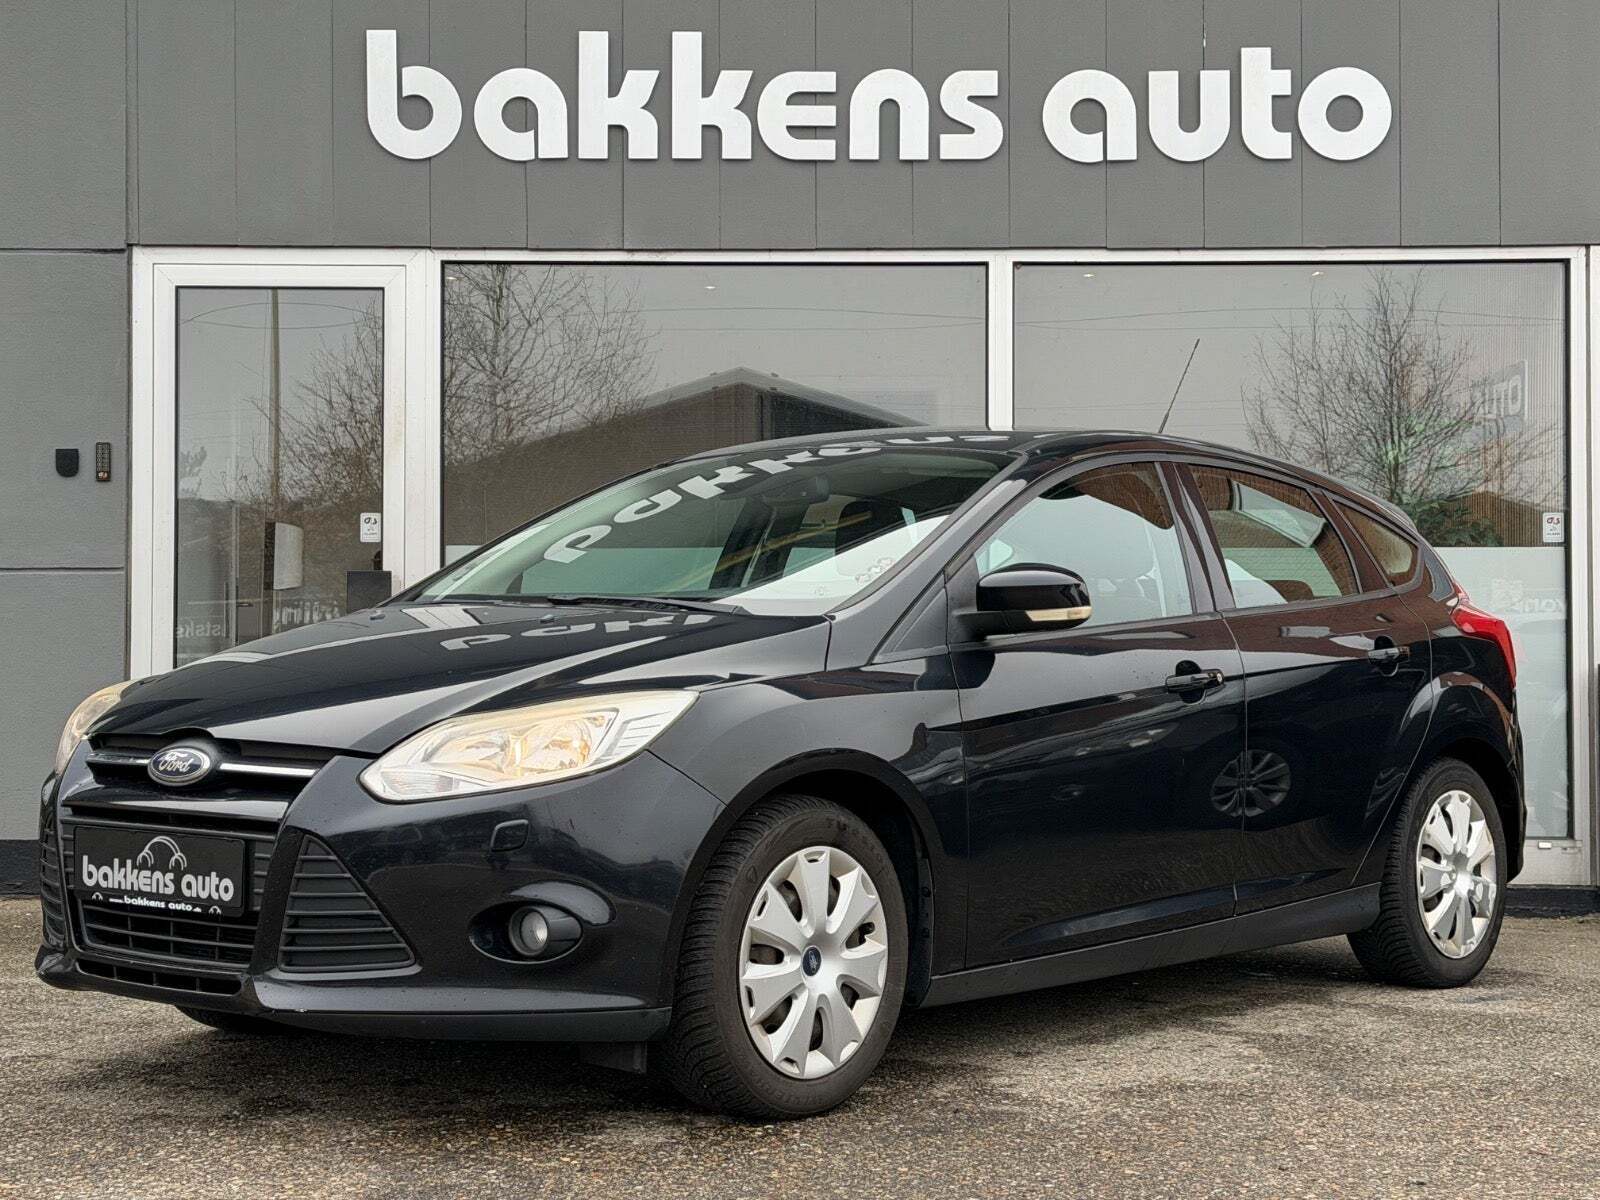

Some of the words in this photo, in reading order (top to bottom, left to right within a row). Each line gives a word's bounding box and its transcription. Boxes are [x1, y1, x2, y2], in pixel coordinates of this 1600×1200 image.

[366, 29, 1004, 161] bakkens
[1042, 47, 1393, 164] auto
[158, 751, 194, 773] Ford
[82, 855, 175, 895] bakkens
[180, 871, 235, 902] auto
